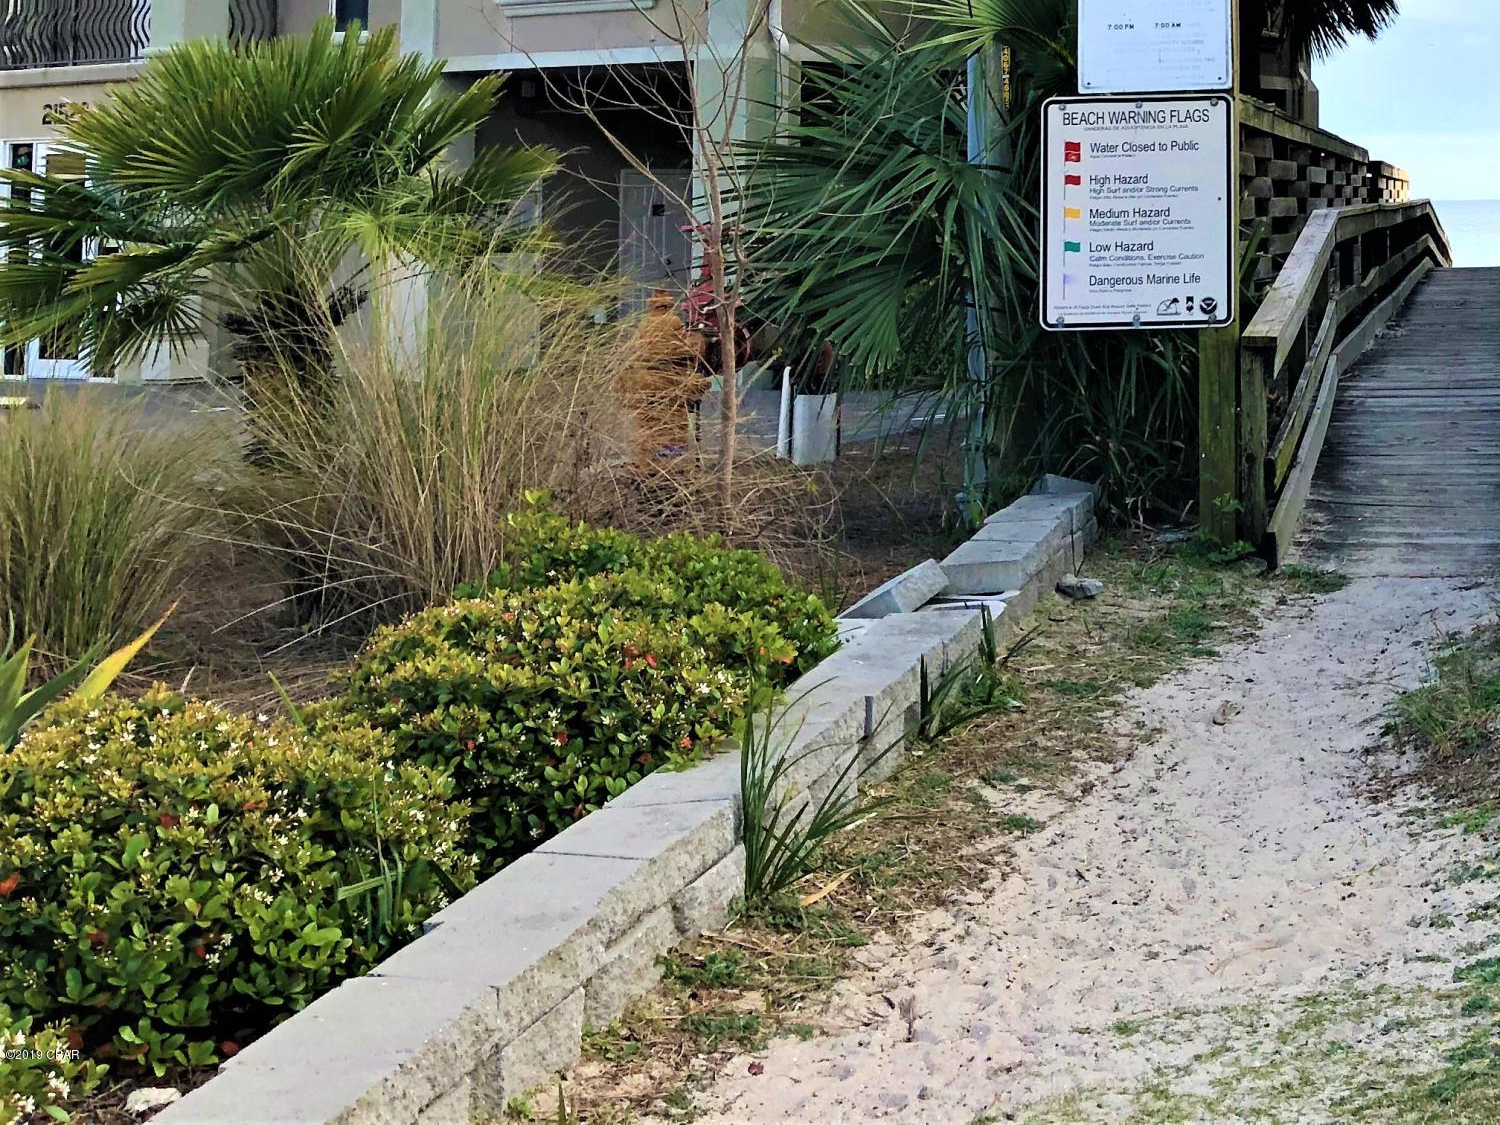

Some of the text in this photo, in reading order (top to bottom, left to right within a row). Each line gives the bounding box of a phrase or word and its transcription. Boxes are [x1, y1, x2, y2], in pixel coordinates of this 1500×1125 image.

[1063, 109, 1210, 125] BEACH WARNING FLAGS
[1090, 140, 1199, 153] Water Closed to Public
[1090, 174, 1148, 187] High Hazard
[1090, 207, 1170, 218] Medium Hazard
[1089, 240, 1154, 252] Low Hazard
[1089, 272, 1201, 288] Dangerous Marine Life
